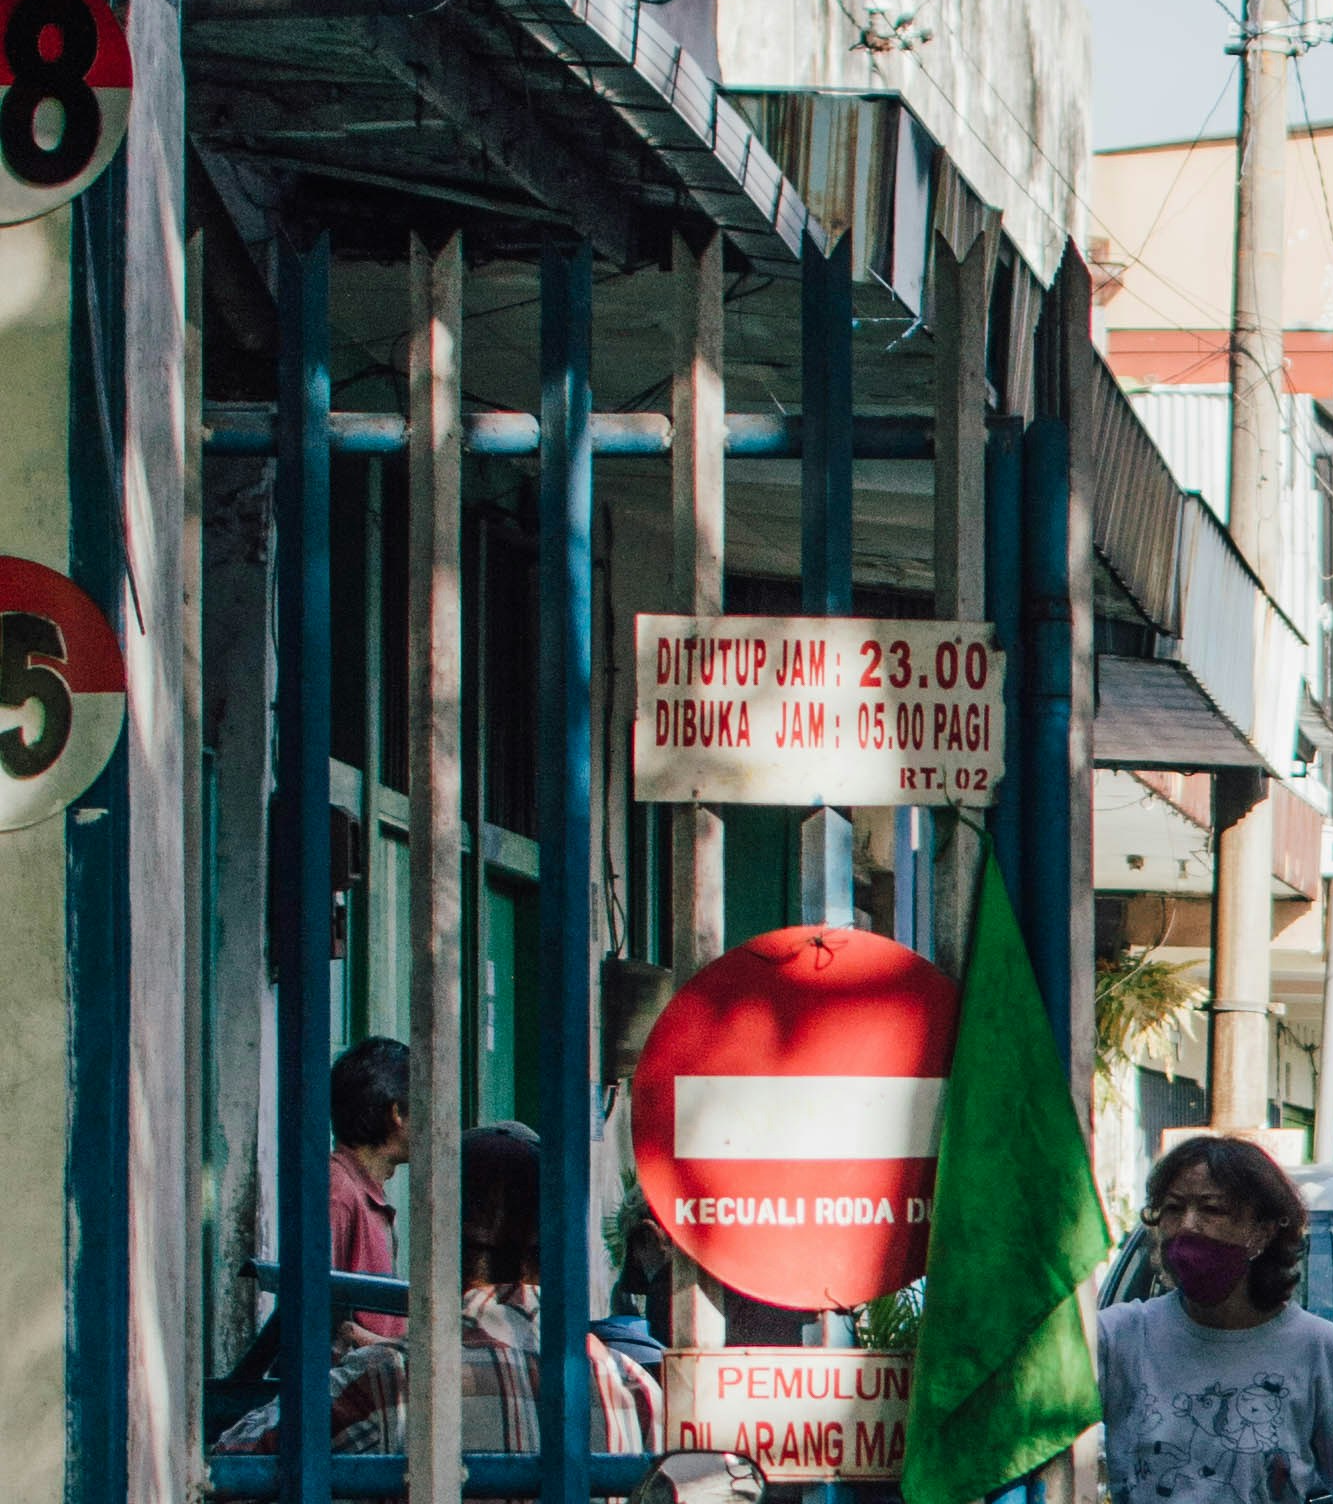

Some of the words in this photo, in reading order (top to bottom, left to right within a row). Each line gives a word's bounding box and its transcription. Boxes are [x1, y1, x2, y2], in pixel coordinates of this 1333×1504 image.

[655, 636, 767, 687] DITUTUP
[859, 639, 988, 691] 23.00
[655, 698, 751, 748] DIBUKA
[857, 701, 925, 751] 05.00
[933, 702, 990, 752] PAGI
[899, 766, 944, 790] RT.
[954, 767, 989, 791] 02
[675, 1196, 805, 1227] KECUALI
[815, 1196, 895, 1226] RODA
